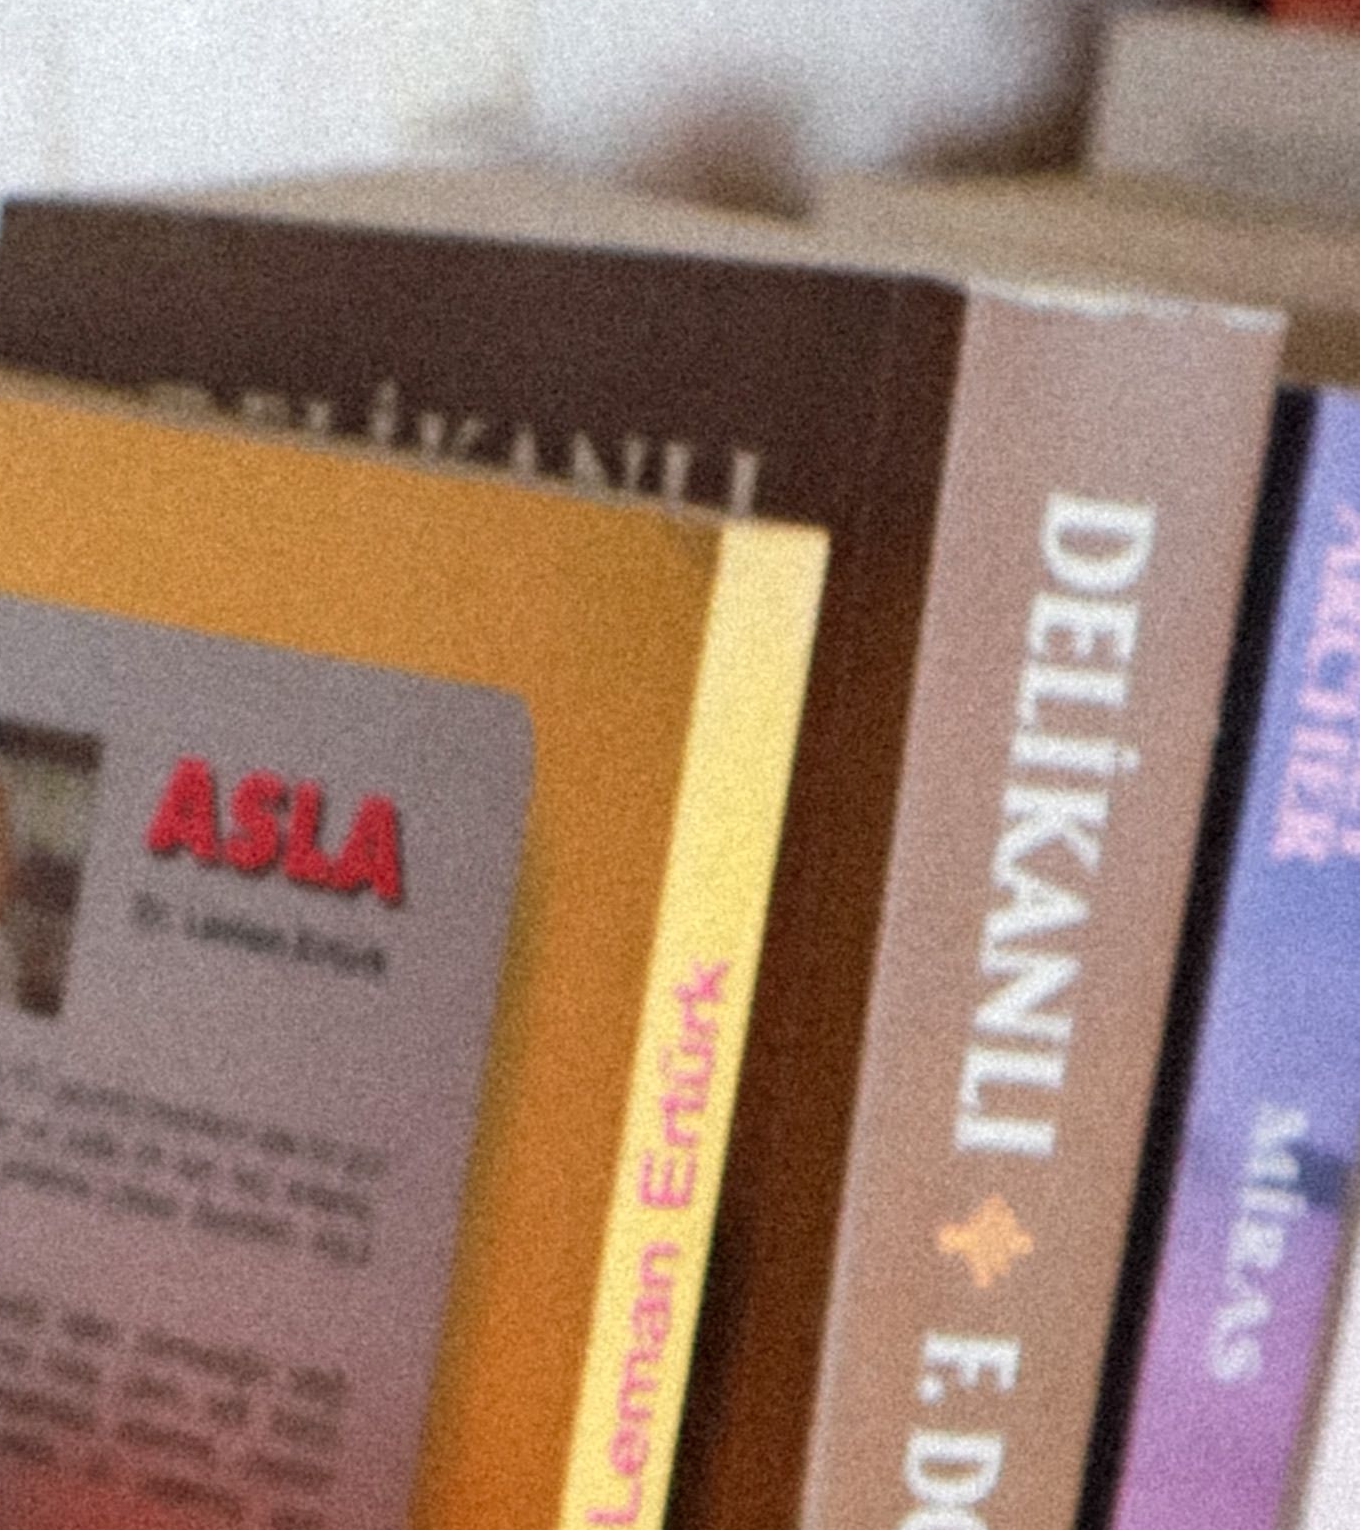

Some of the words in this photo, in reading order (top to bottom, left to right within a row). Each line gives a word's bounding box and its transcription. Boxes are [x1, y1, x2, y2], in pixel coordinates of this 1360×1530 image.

[145, 756, 407, 908] ASLA
[955, 491, 1155, 1157] DELİKANLI
[585, 1238, 681, 1528] Leman
[636, 960, 731, 1208] Ertürk
[918, 1330, 1021, 1405] F.
